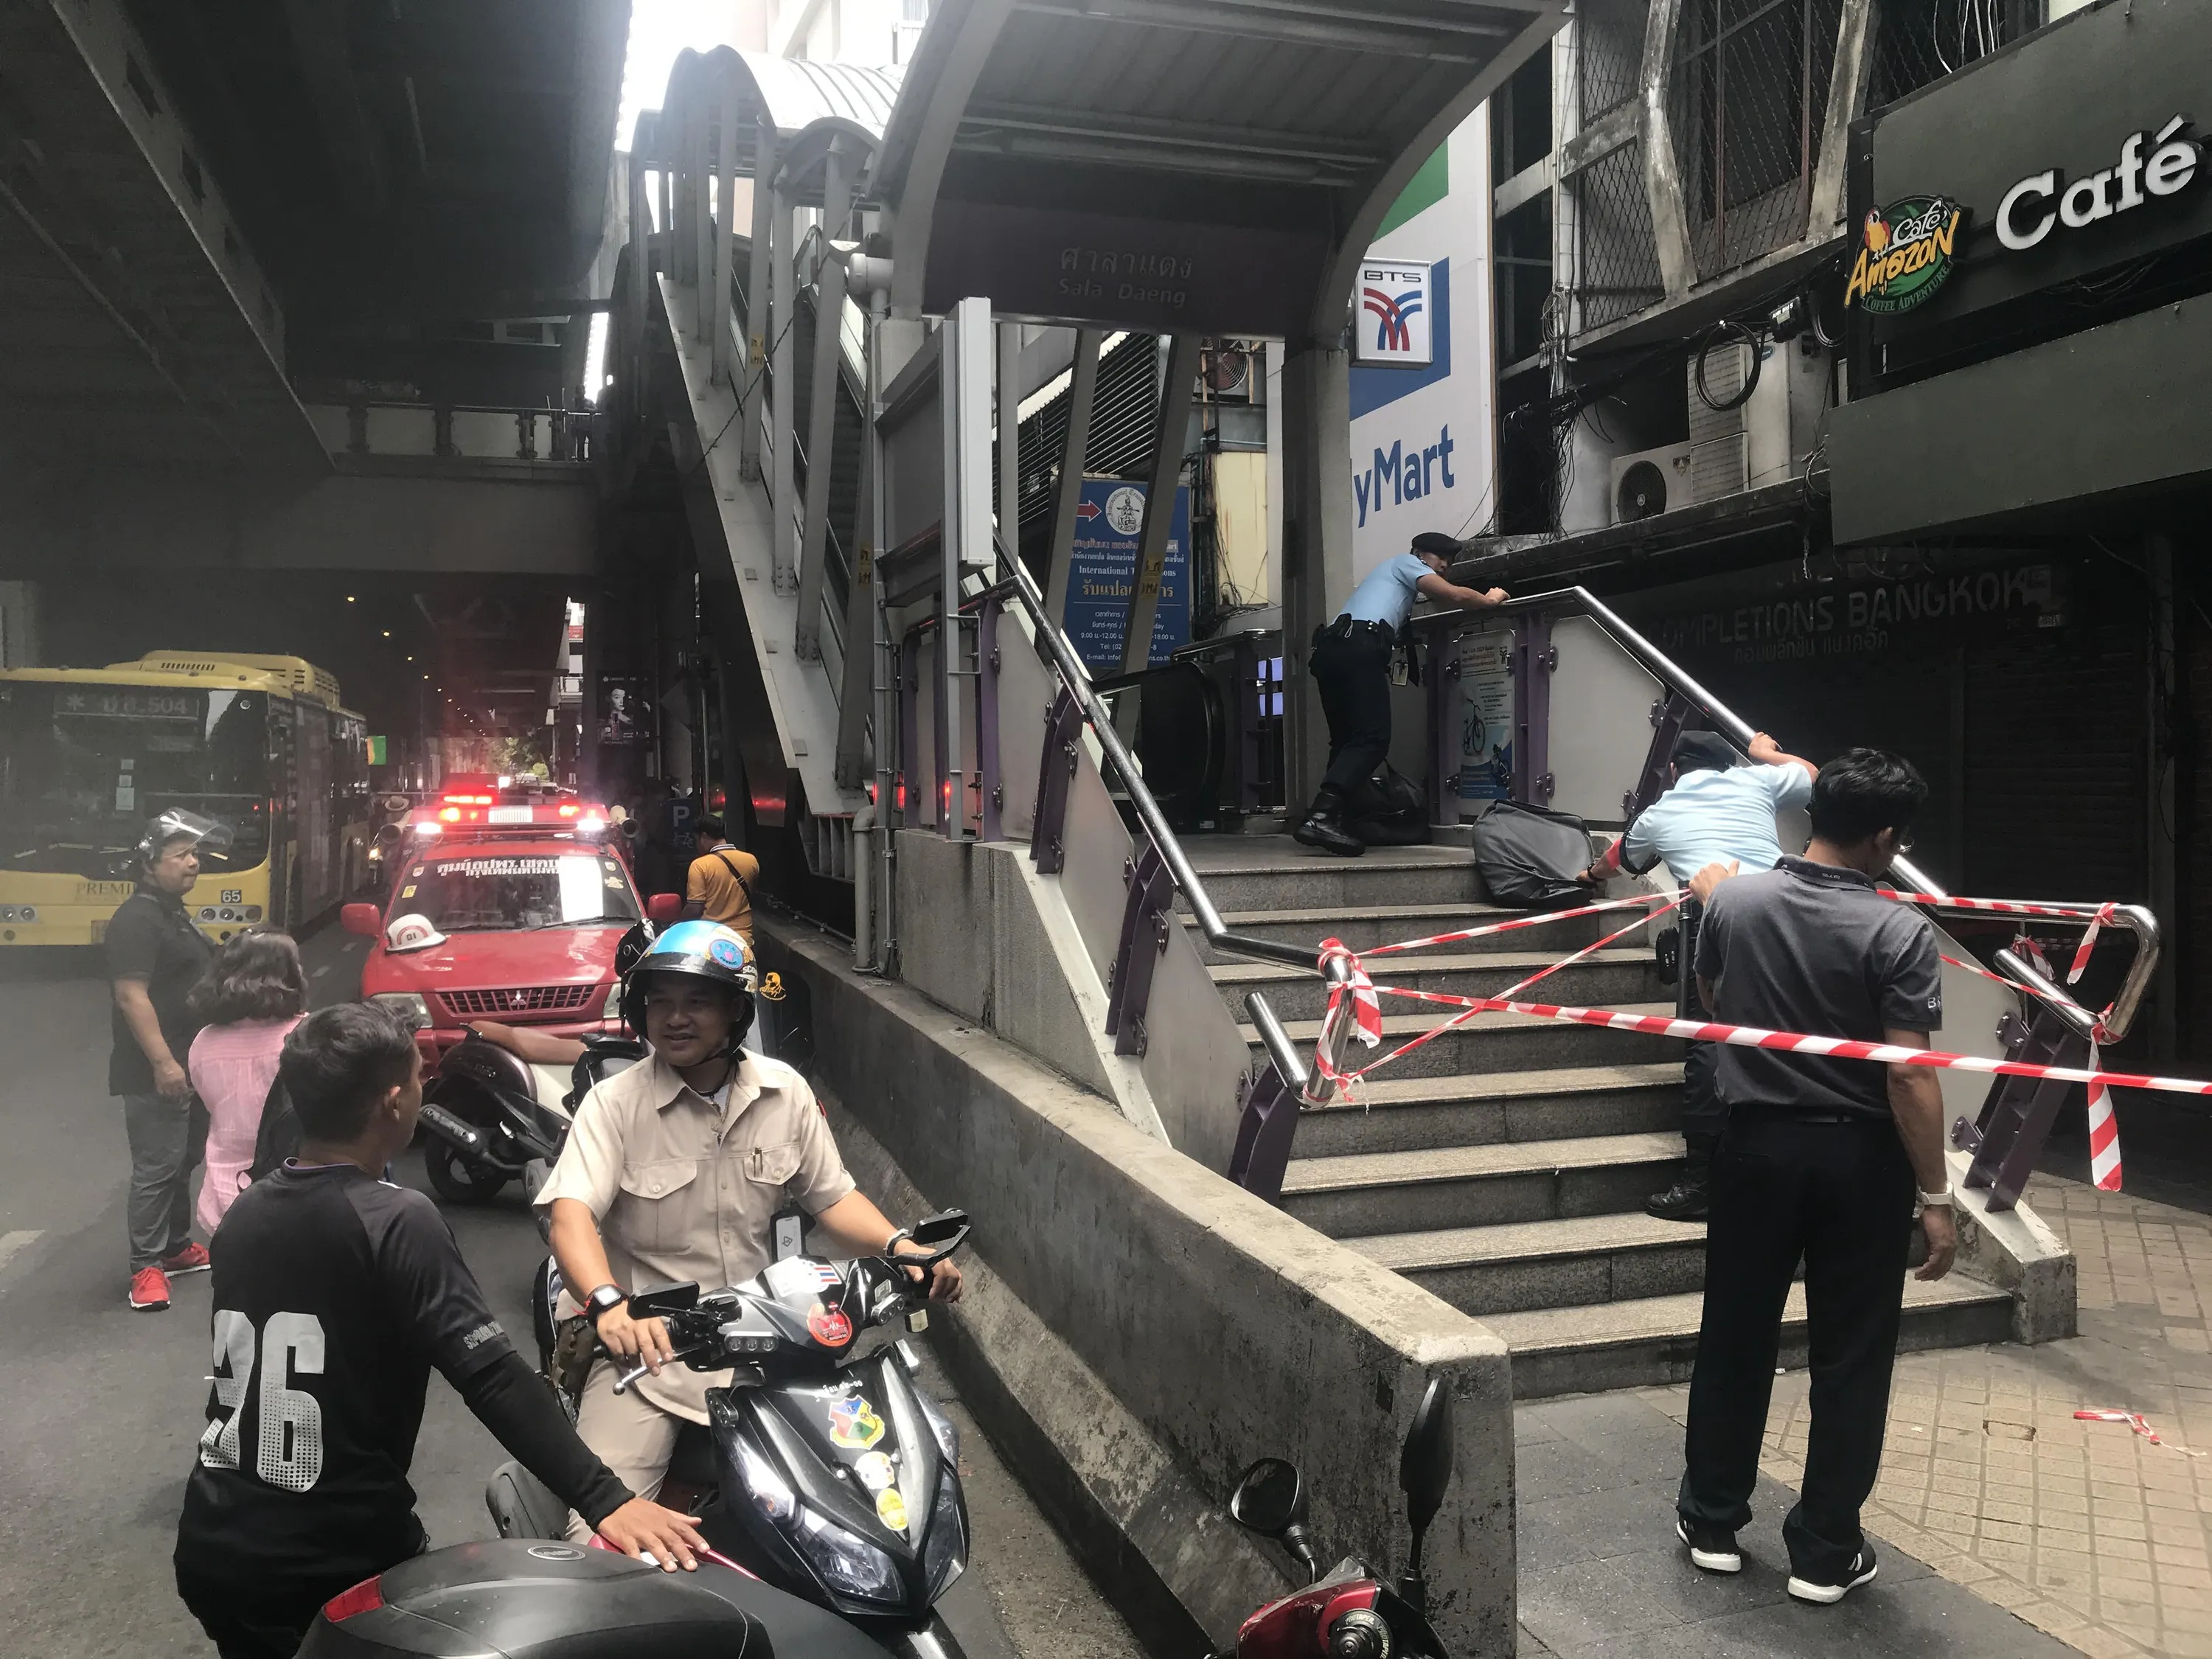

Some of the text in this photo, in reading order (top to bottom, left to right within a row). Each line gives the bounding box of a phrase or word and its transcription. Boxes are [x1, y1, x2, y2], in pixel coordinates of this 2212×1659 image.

[1995, 114, 2197, 250] Café
[1890, 199, 1948, 248] Café
[1060, 246, 1193, 279] ศาลาแดง
[1363, 270, 1422, 283] BTS
[1058, 277, 1186, 310] Sala Daeng
[1353, 423, 1455, 529] yMart
[1079, 566, 1128, 576] International
[1848, 571, 2028, 628] BANGKOK
[672, 805, 690, 827] P
[77, 882, 136, 895] PREMI
[222, 891, 241, 902] 65
[1345, 1613, 1375, 1625] PROTAPER
